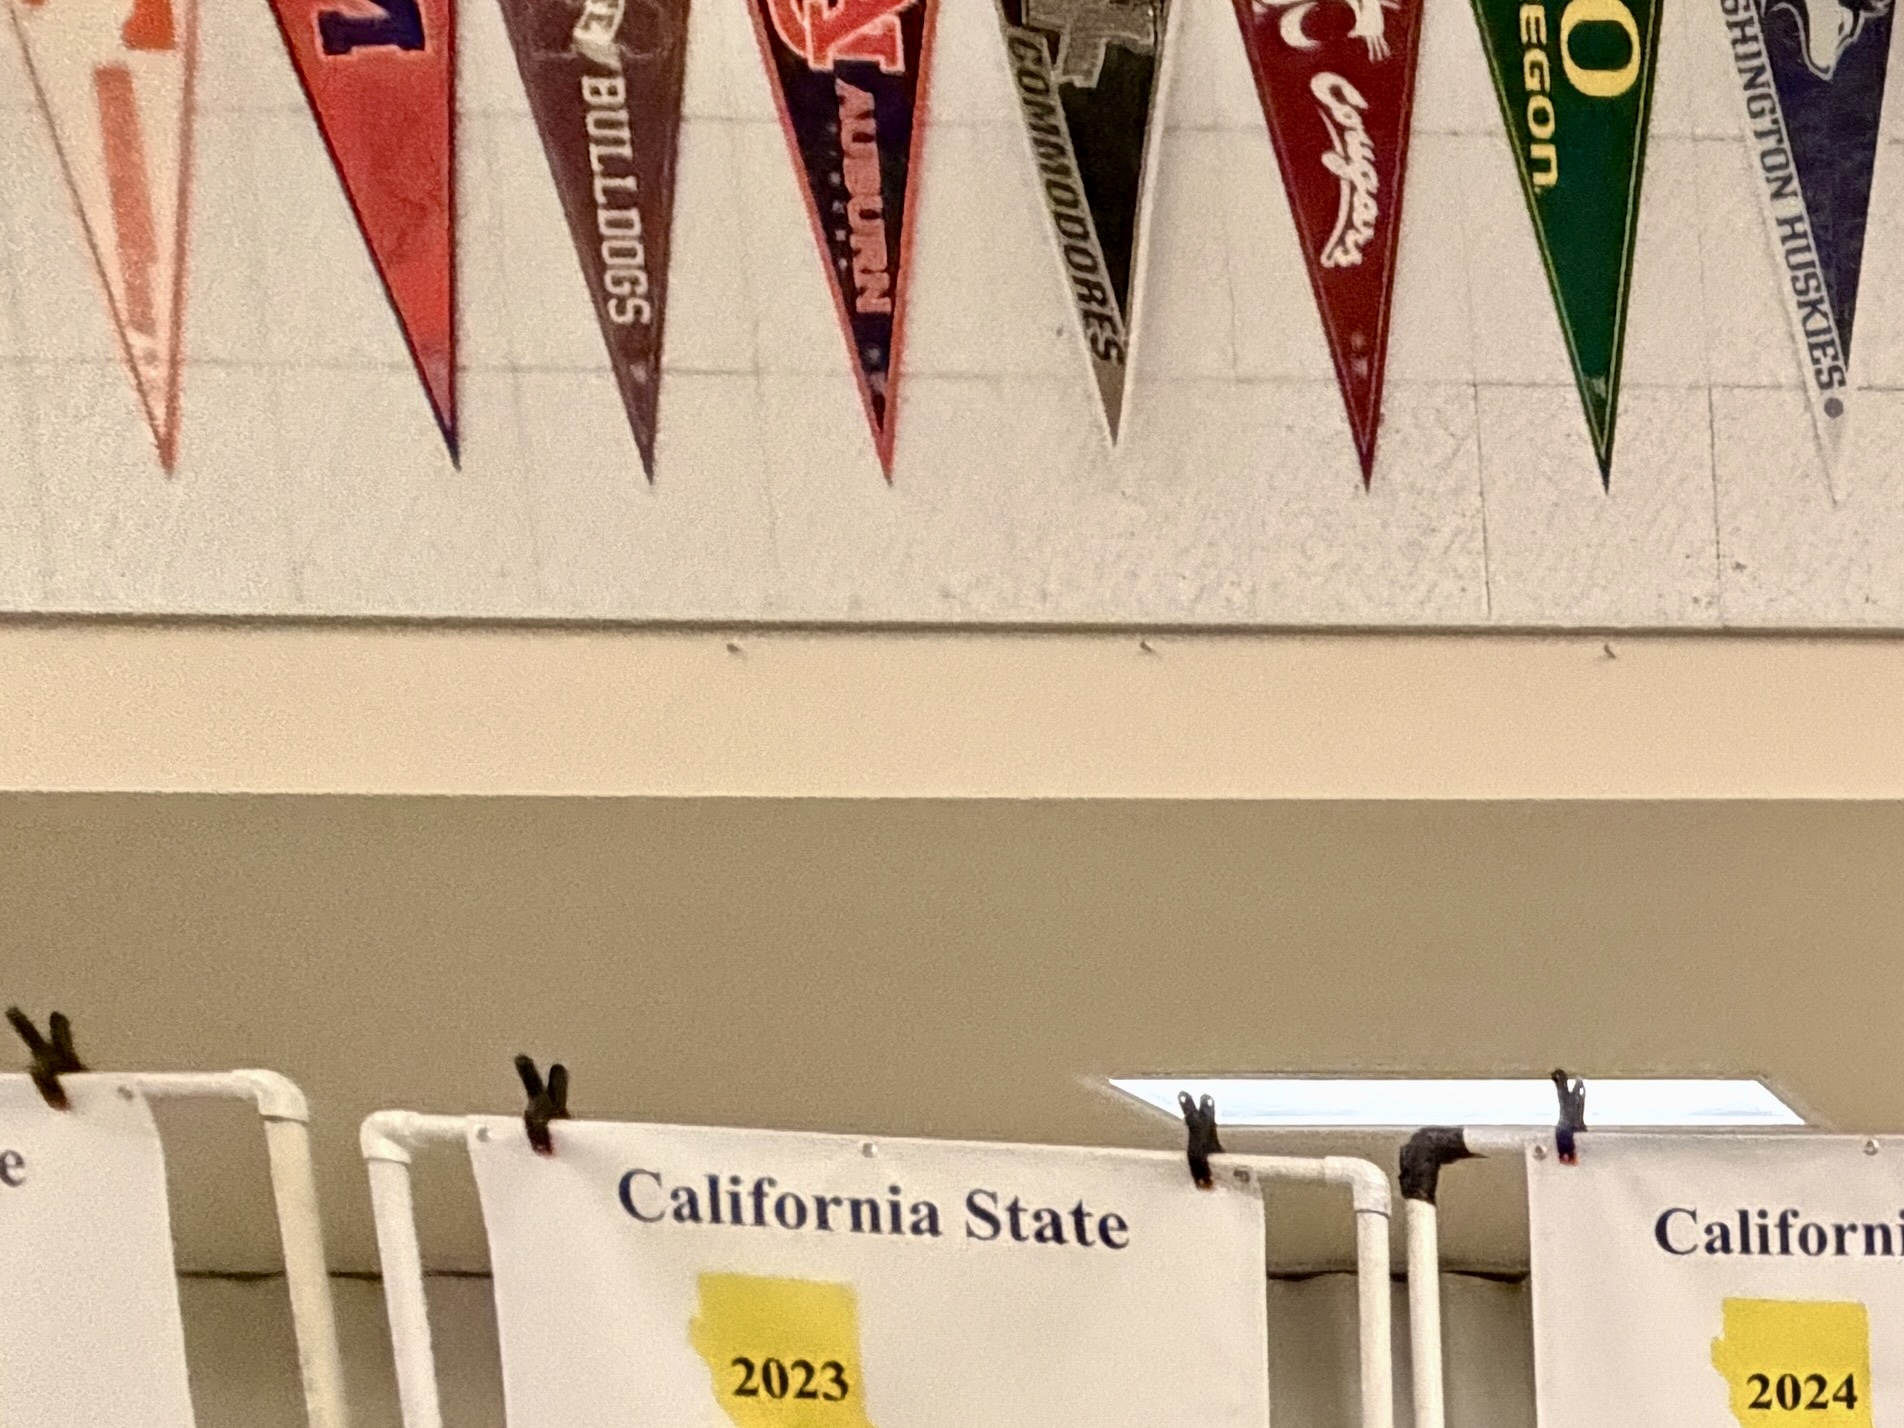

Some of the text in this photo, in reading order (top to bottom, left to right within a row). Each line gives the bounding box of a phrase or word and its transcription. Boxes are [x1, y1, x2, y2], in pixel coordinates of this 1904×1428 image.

[580, 75, 651, 326] BULLDOGS
[833, 79, 892, 315] AUBURN
[1003, 28, 1125, 366] COMMODORES
[1308, 71, 1382, 269] Cougars
[1775, 215, 1847, 391] HUSKIES
[617, 1167, 1131, 1251] California State
[731, 1356, 850, 1402] 2023
[1746, 1371, 1859, 1412] 2024
